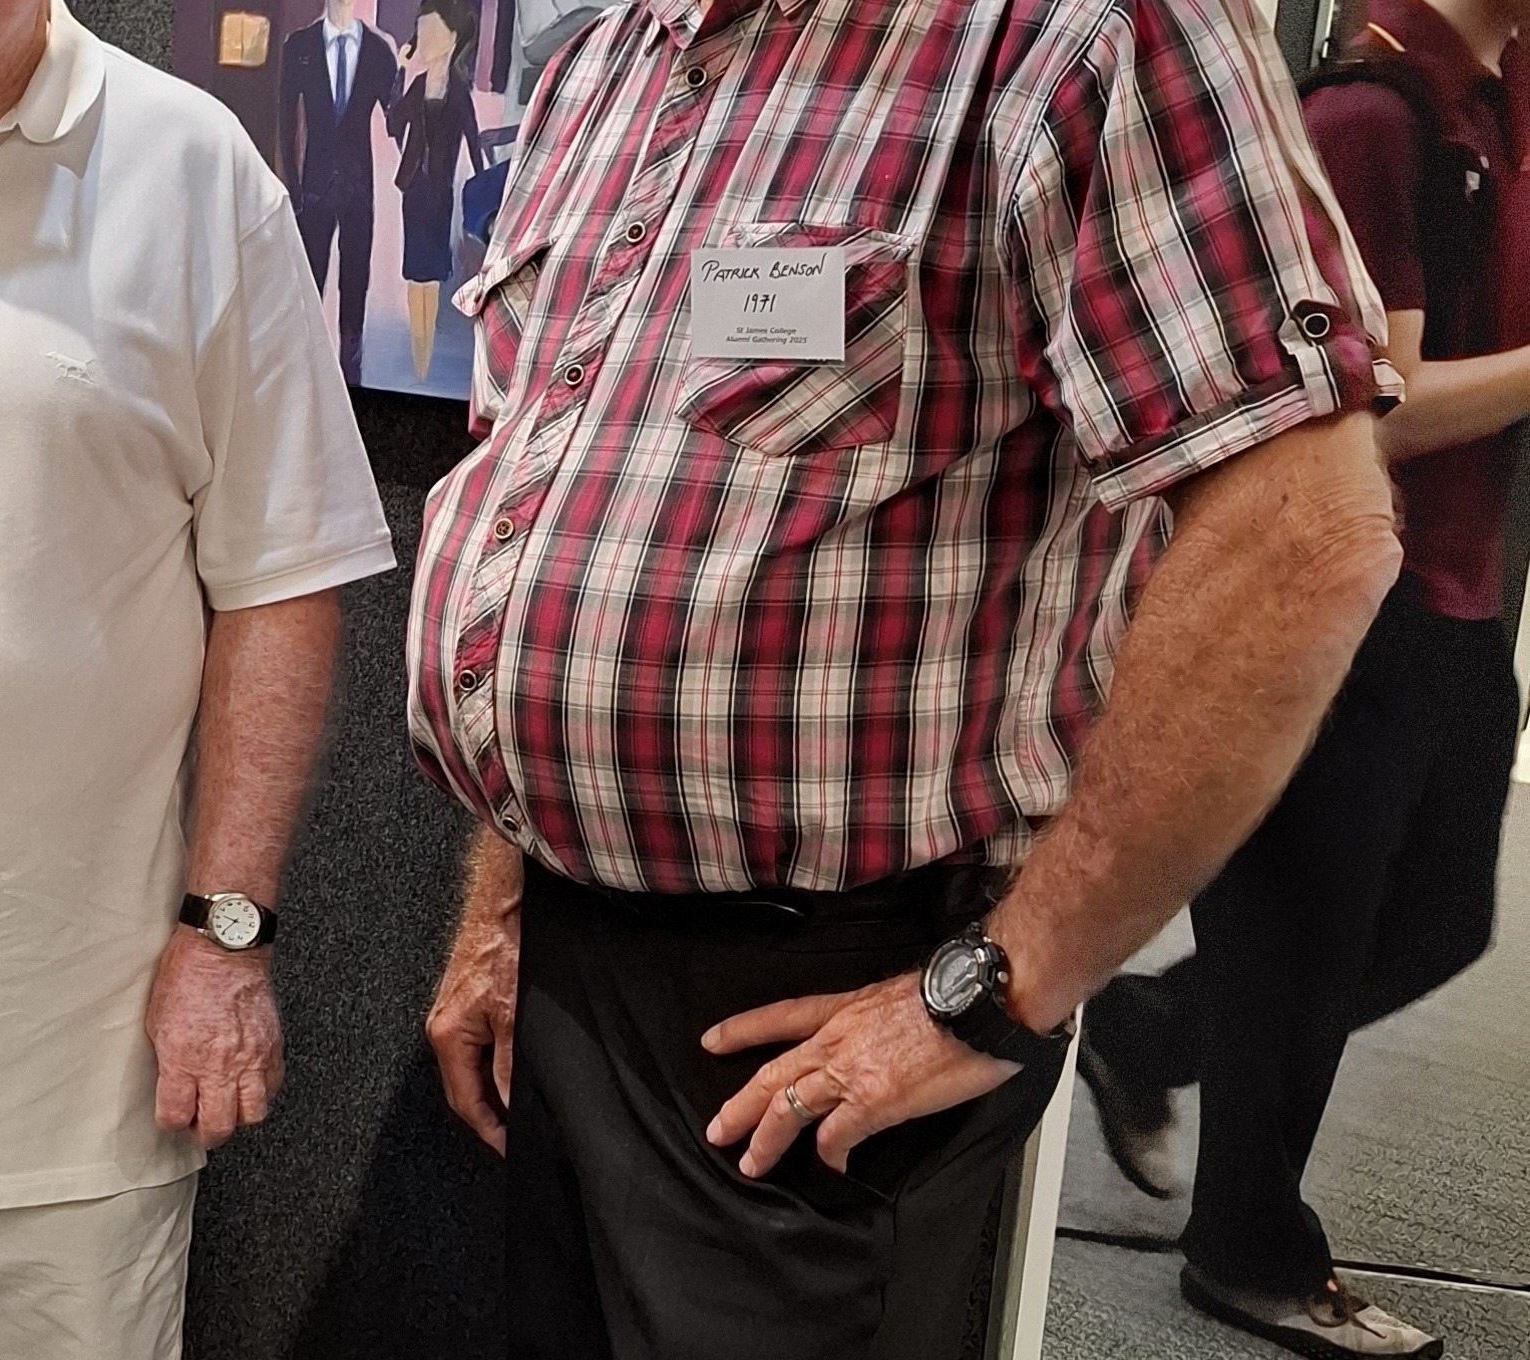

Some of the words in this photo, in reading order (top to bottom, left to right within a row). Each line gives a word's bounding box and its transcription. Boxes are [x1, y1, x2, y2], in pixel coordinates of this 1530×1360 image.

[701, 259, 760, 283] PATRICK
[769, 252, 827, 279] BENSON
[743, 293, 777, 313] 1971
[769, 327, 797, 336] College
